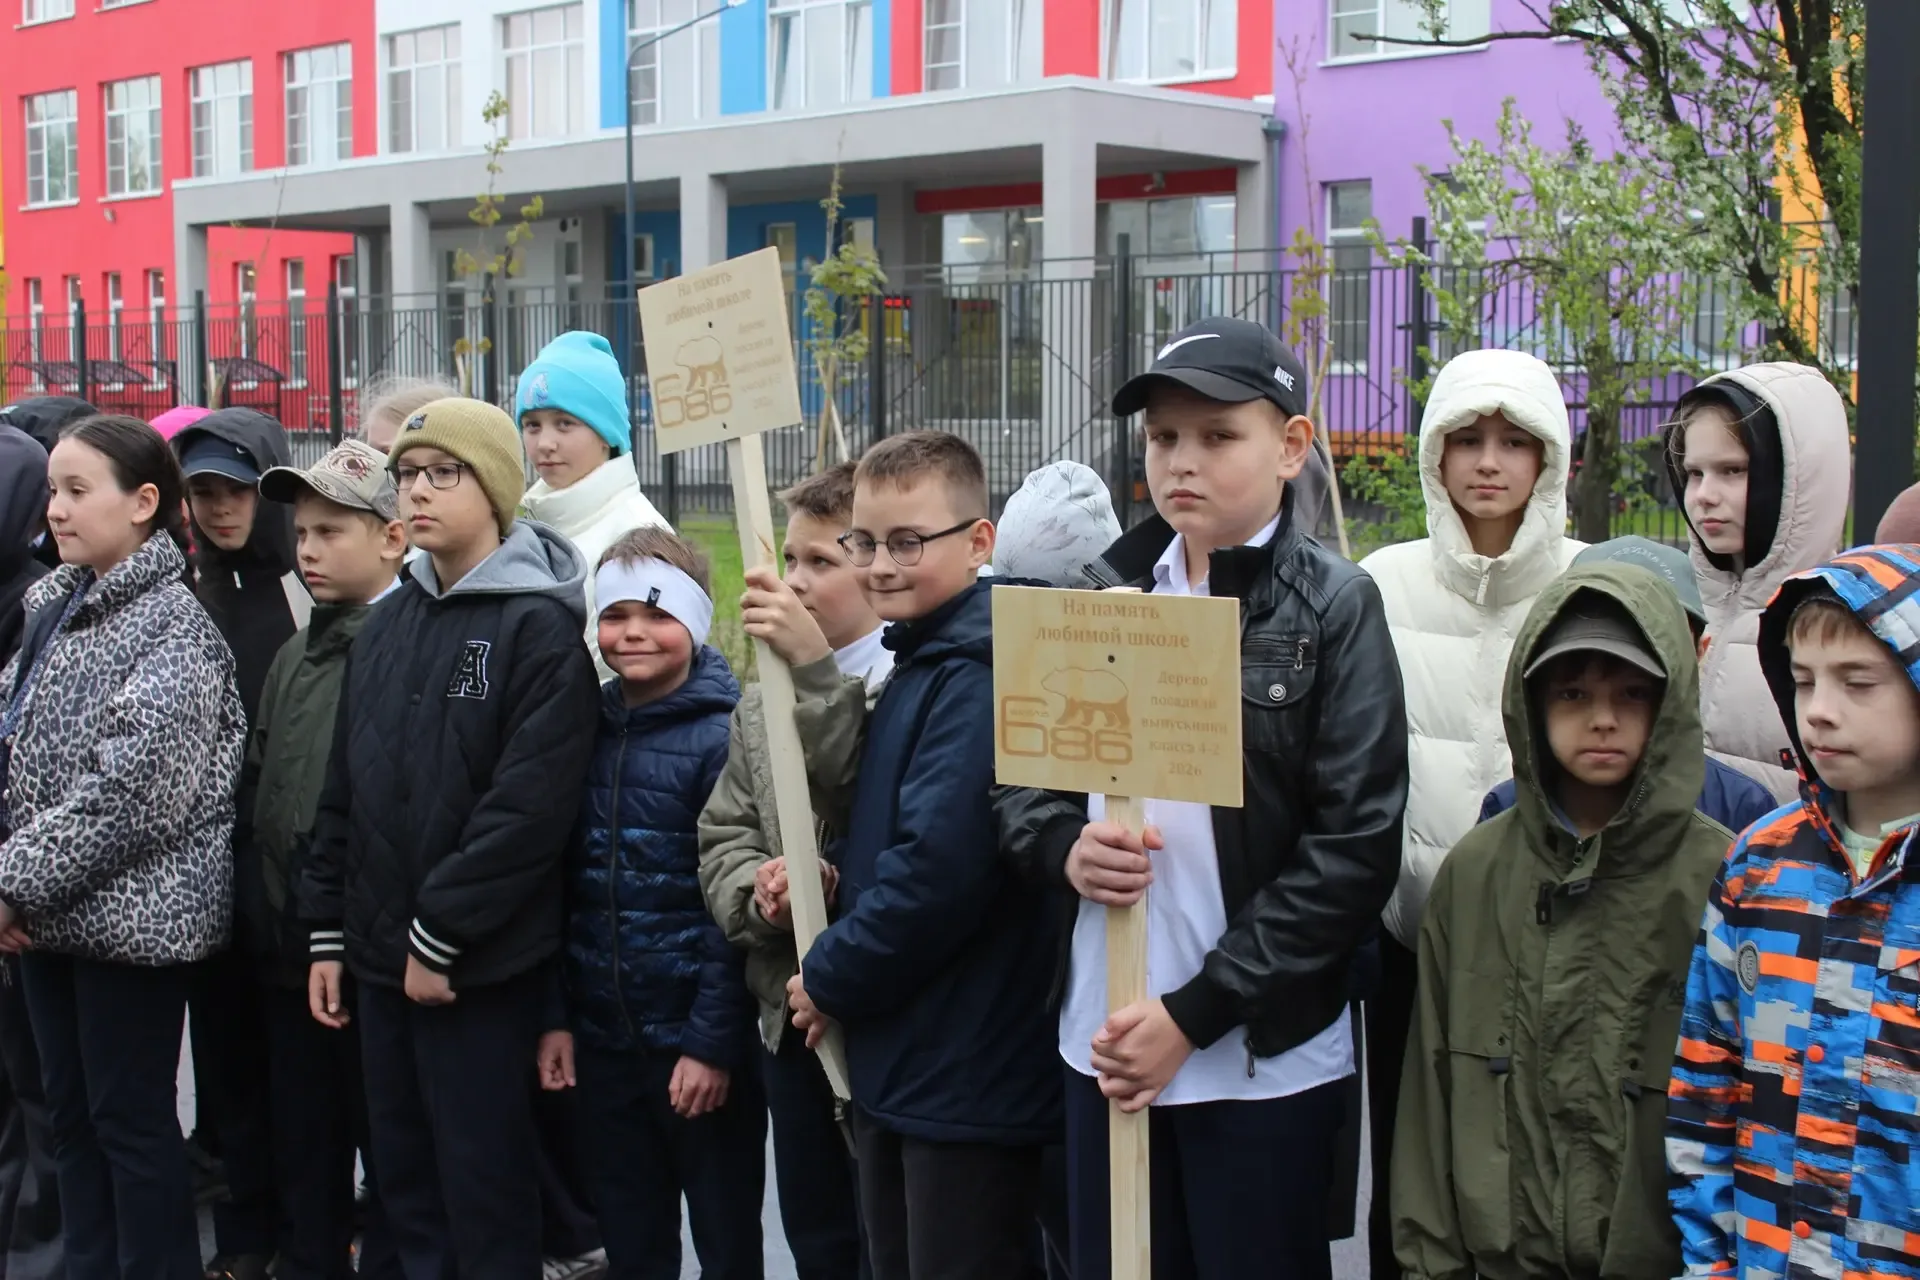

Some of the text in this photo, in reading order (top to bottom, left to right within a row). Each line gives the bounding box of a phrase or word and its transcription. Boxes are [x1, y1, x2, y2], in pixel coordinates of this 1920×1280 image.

[1274, 366, 1295, 392] NIKE
[654, 373, 733, 429] 686
[1063, 598, 1160, 620] На память
[1036, 625, 1190, 649] любимой школе
[447, 640, 491, 700] A
[1157, 670, 1208, 688] Дерево
[1000, 696, 1132, 765] 686
[1141, 717, 1228, 736] выпускники
[1149, 740, 1196, 755] класса
[1168, 761, 1203, 777] 2026
